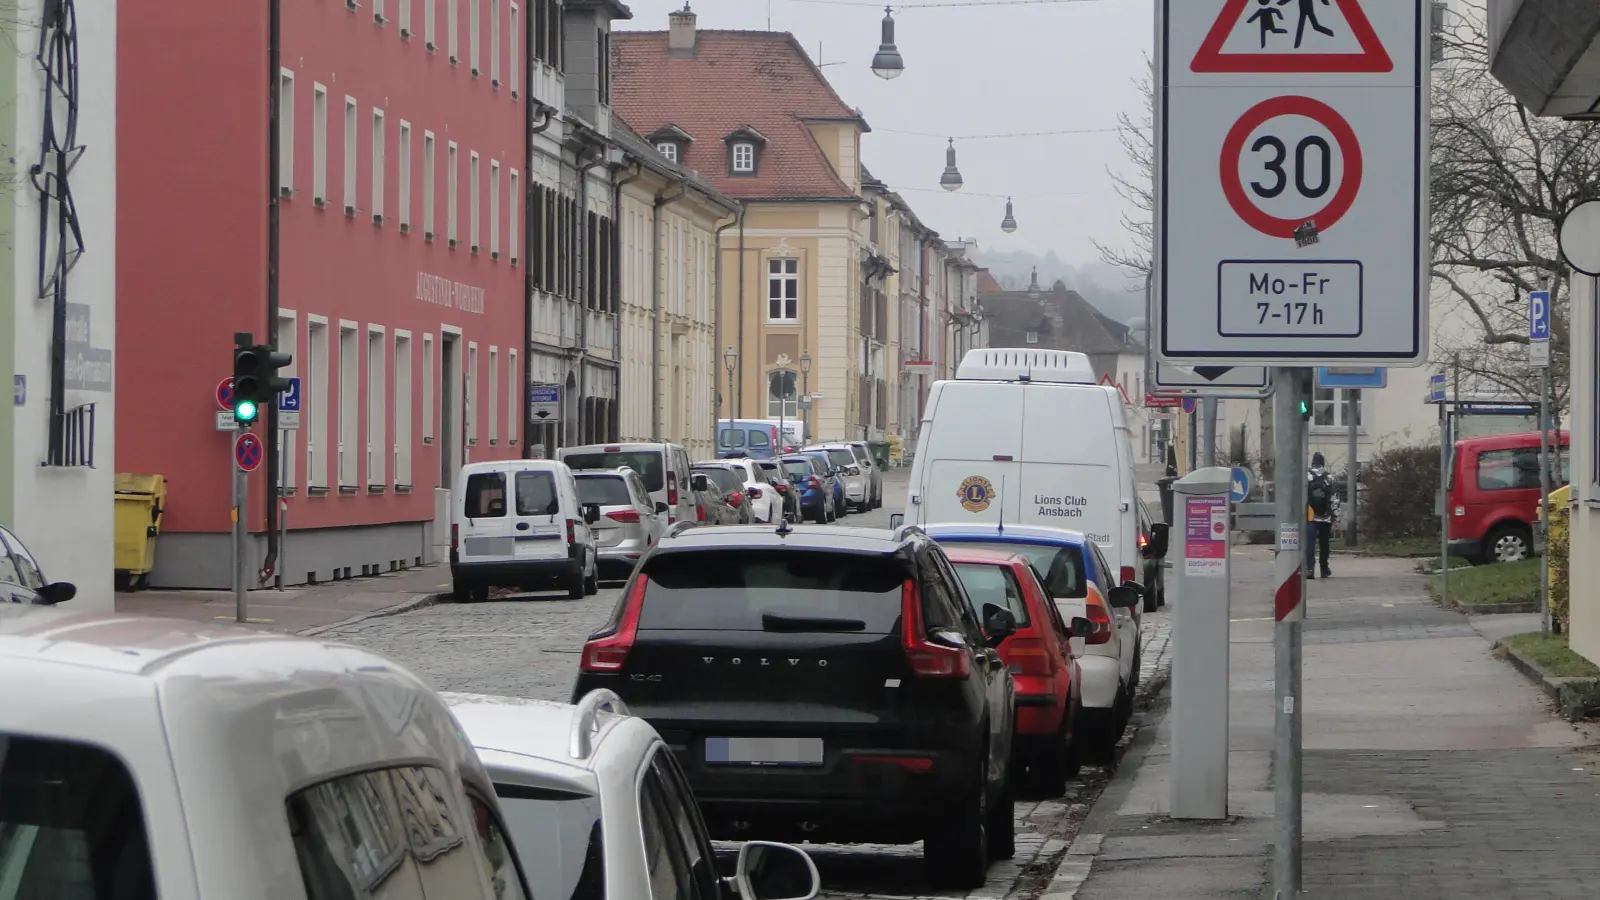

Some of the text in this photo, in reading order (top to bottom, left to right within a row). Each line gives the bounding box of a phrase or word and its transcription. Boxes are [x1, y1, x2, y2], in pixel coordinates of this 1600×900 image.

[1250, 135, 1331, 198] 30
[1298, 236, 1319, 248] 1900
[1249, 272, 1330, 295] Mo-Fr
[1532, 297, 1544, 333] P
[965, 476, 988, 486] LIONS
[971, 486, 982, 500] L
[1034, 494, 1087, 506] Lions Club
[1038, 506, 1082, 517] Ansbach
[702, 656, 829, 668] VOLVO
[629, 673, 663, 683] XC40
